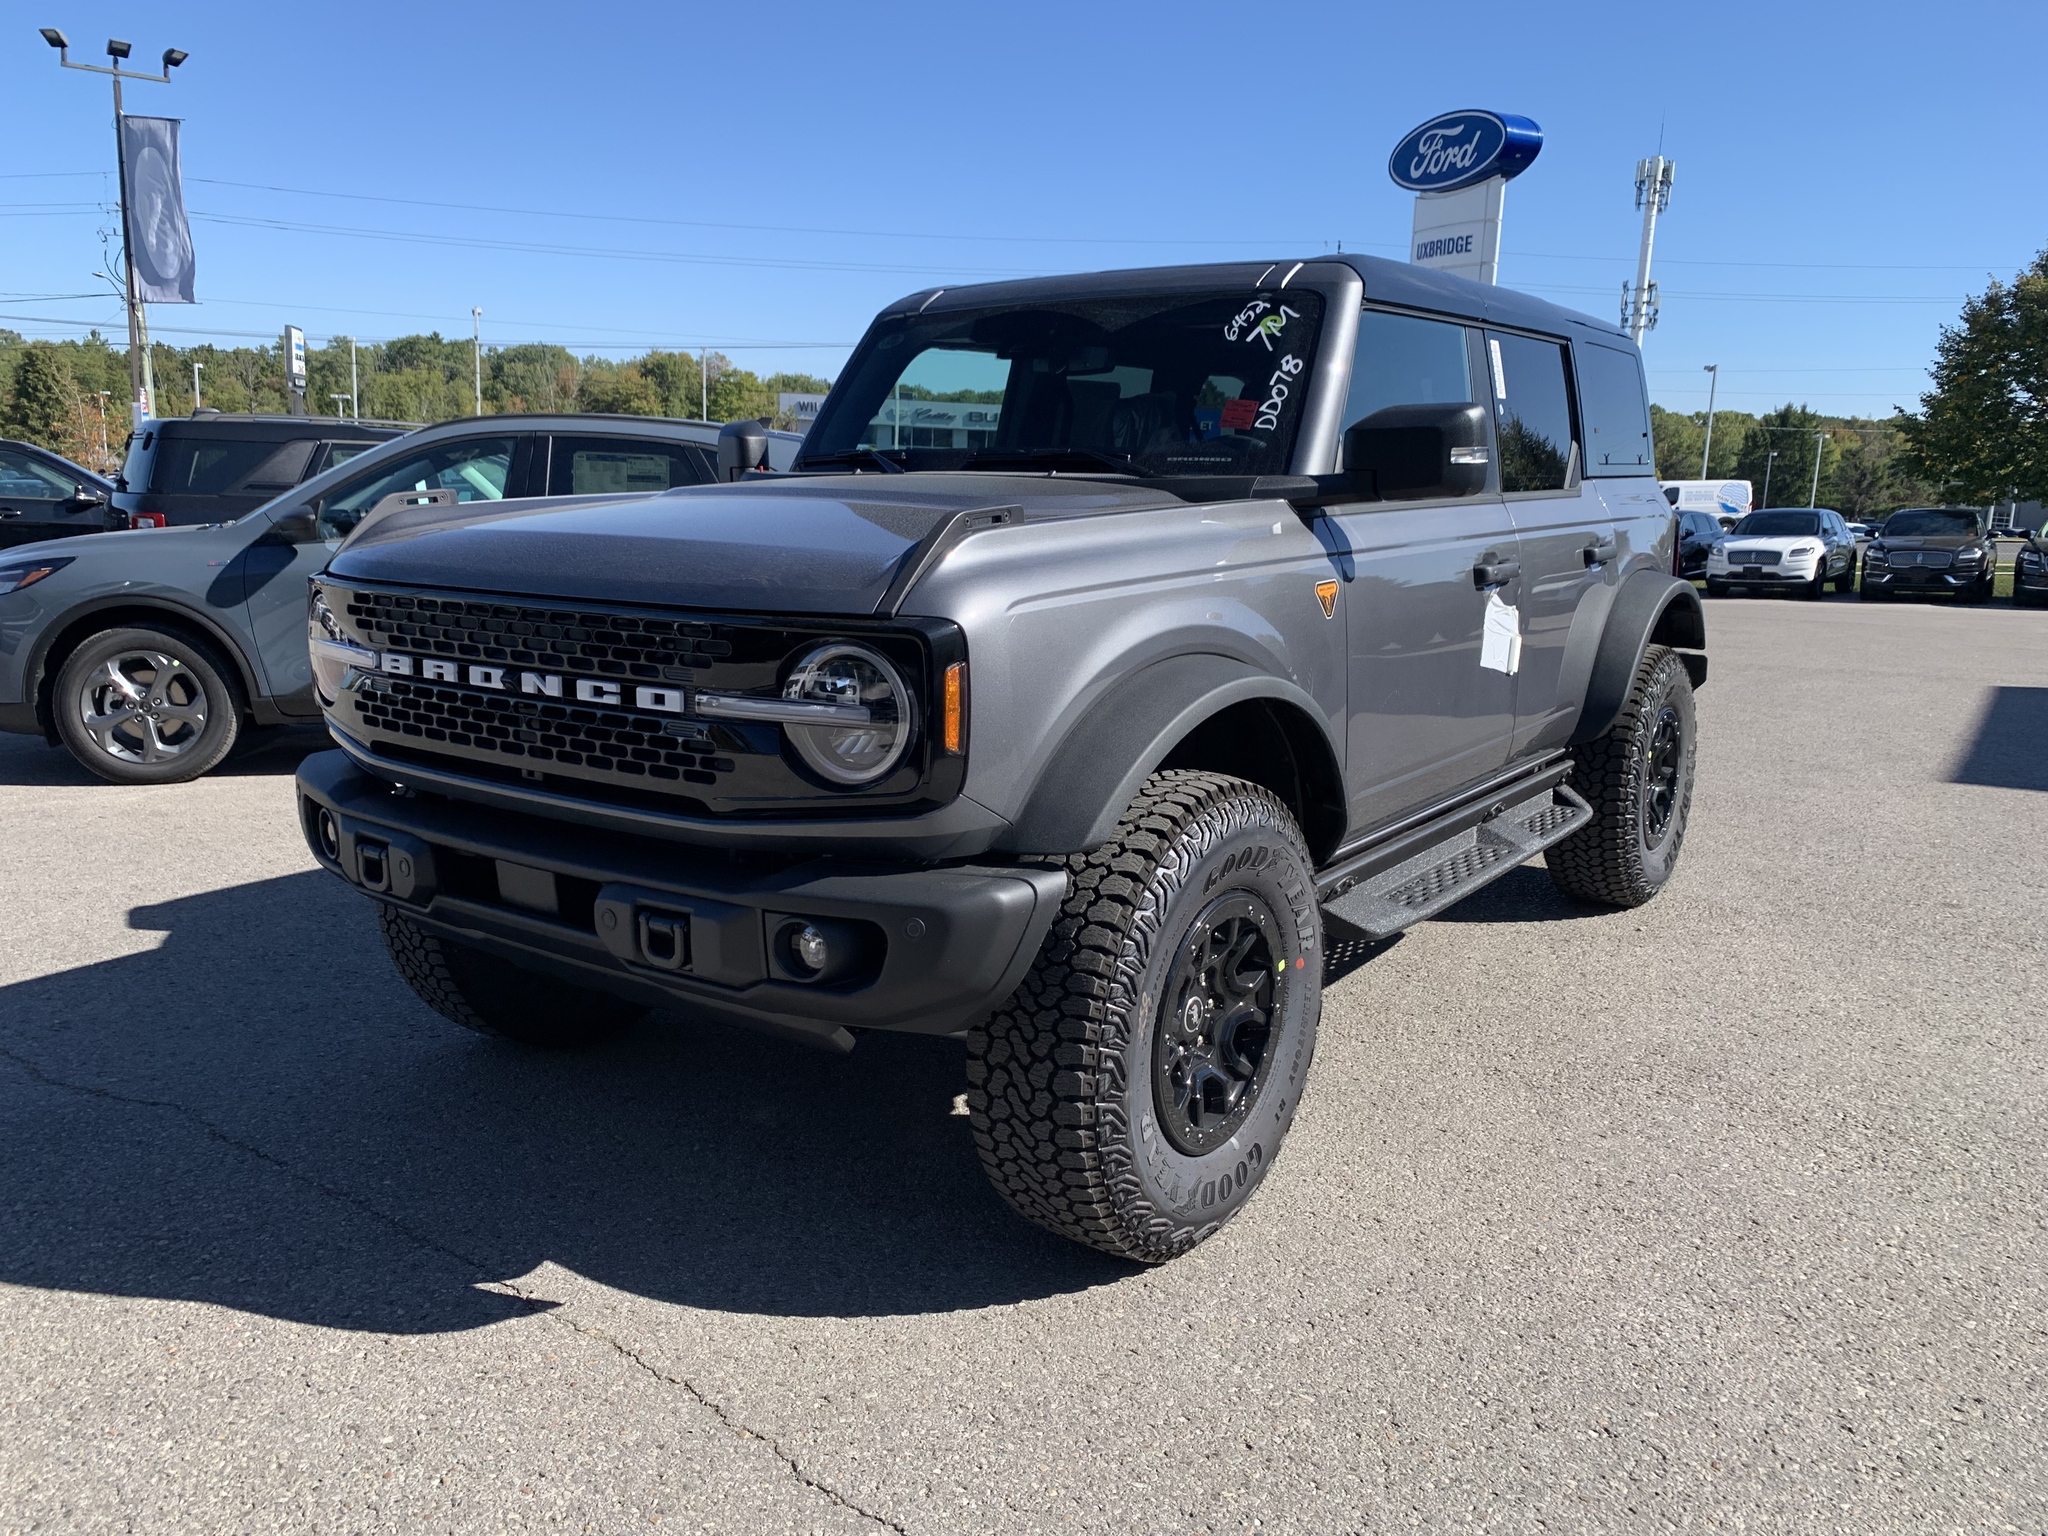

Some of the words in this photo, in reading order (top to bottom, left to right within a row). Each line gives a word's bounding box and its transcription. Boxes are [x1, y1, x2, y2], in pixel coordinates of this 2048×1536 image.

[1410, 123, 1481, 179] Ford
[1416, 234, 1473, 261] UXBRIDGE
[1224, 300, 1271, 341] 6452
[381, 652, 685, 713] BRONCO
